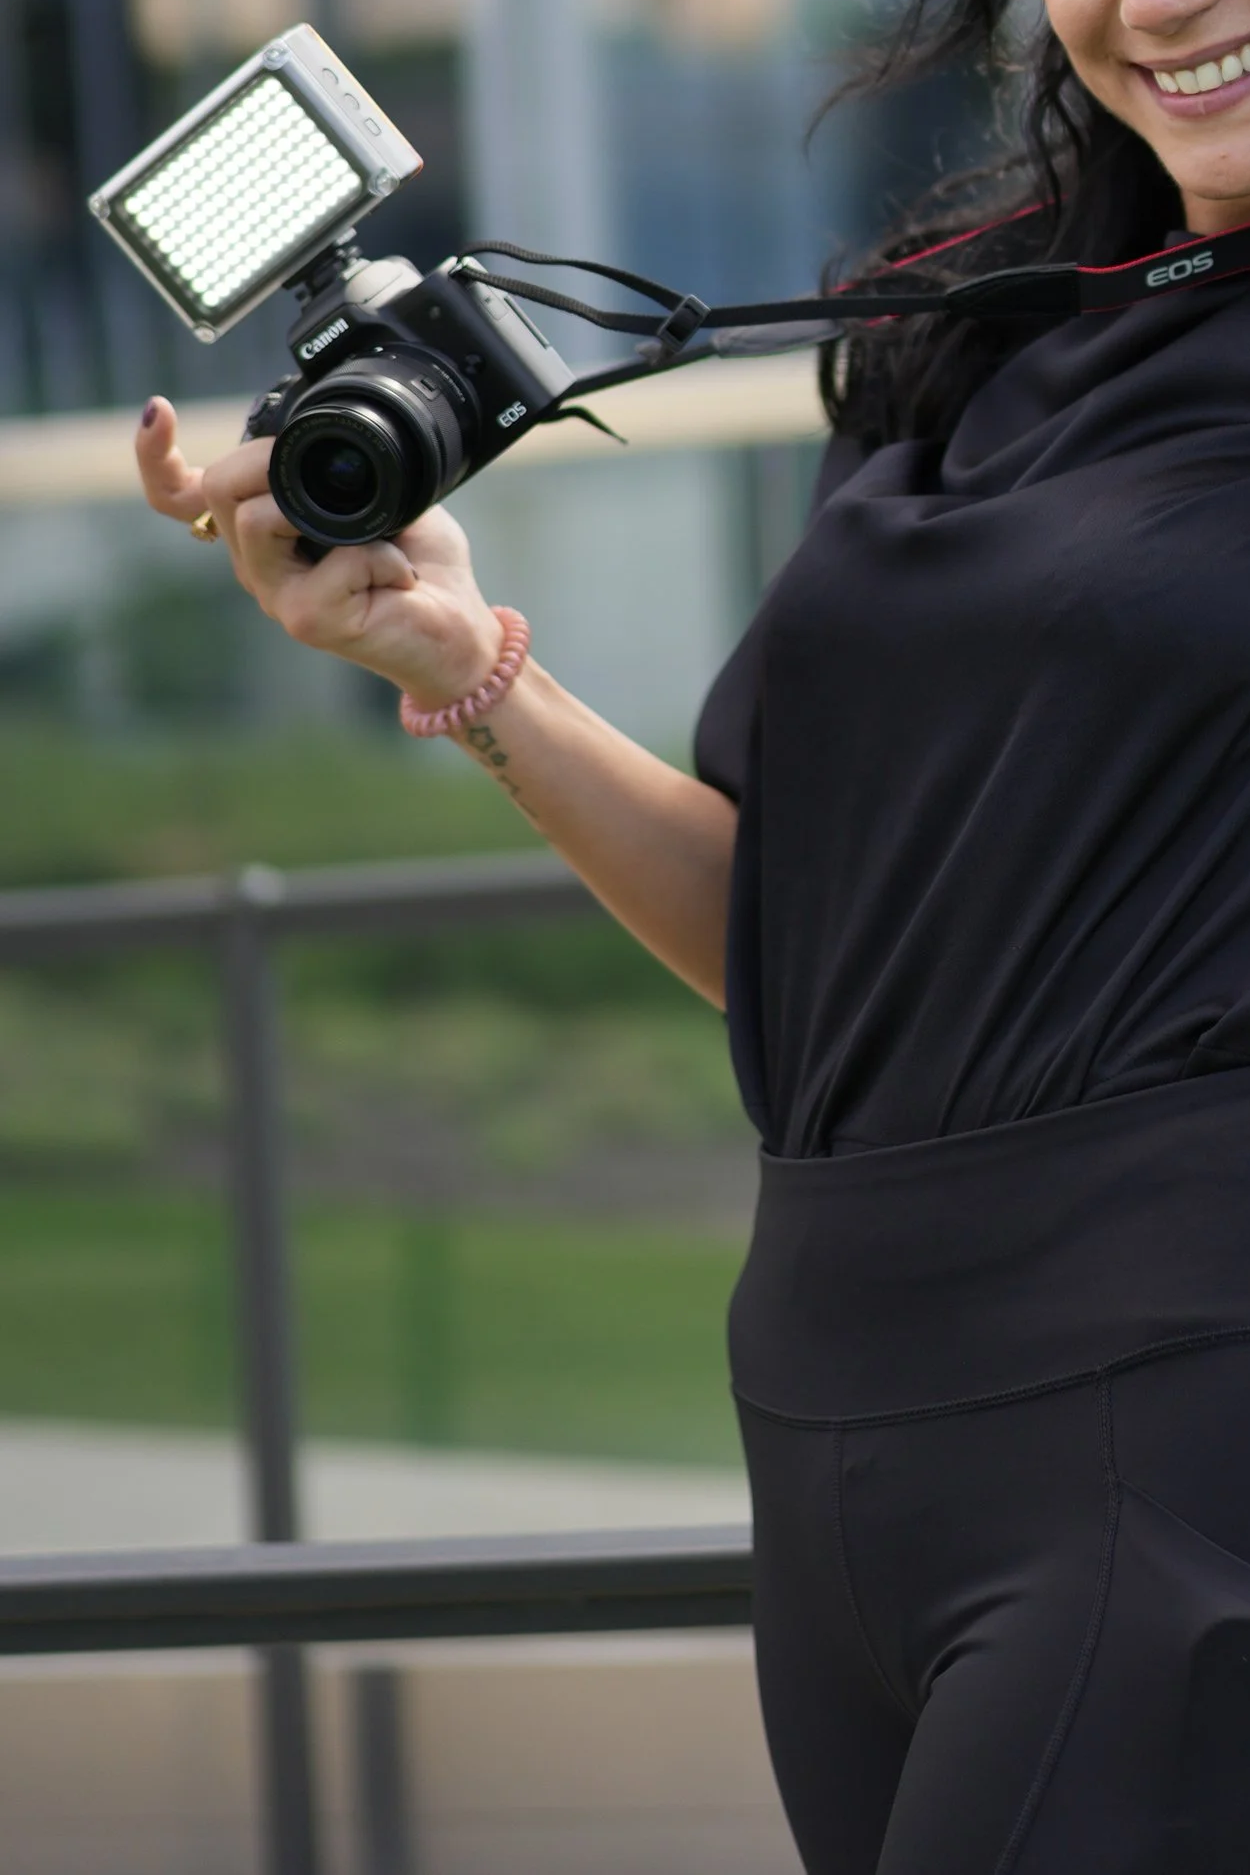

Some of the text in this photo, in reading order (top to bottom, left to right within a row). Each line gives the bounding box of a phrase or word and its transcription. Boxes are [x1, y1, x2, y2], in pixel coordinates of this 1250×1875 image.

[1145, 251, 1214, 287] EOS
[300, 317, 350, 360] Canon
[498, 400, 528, 428] EOS
